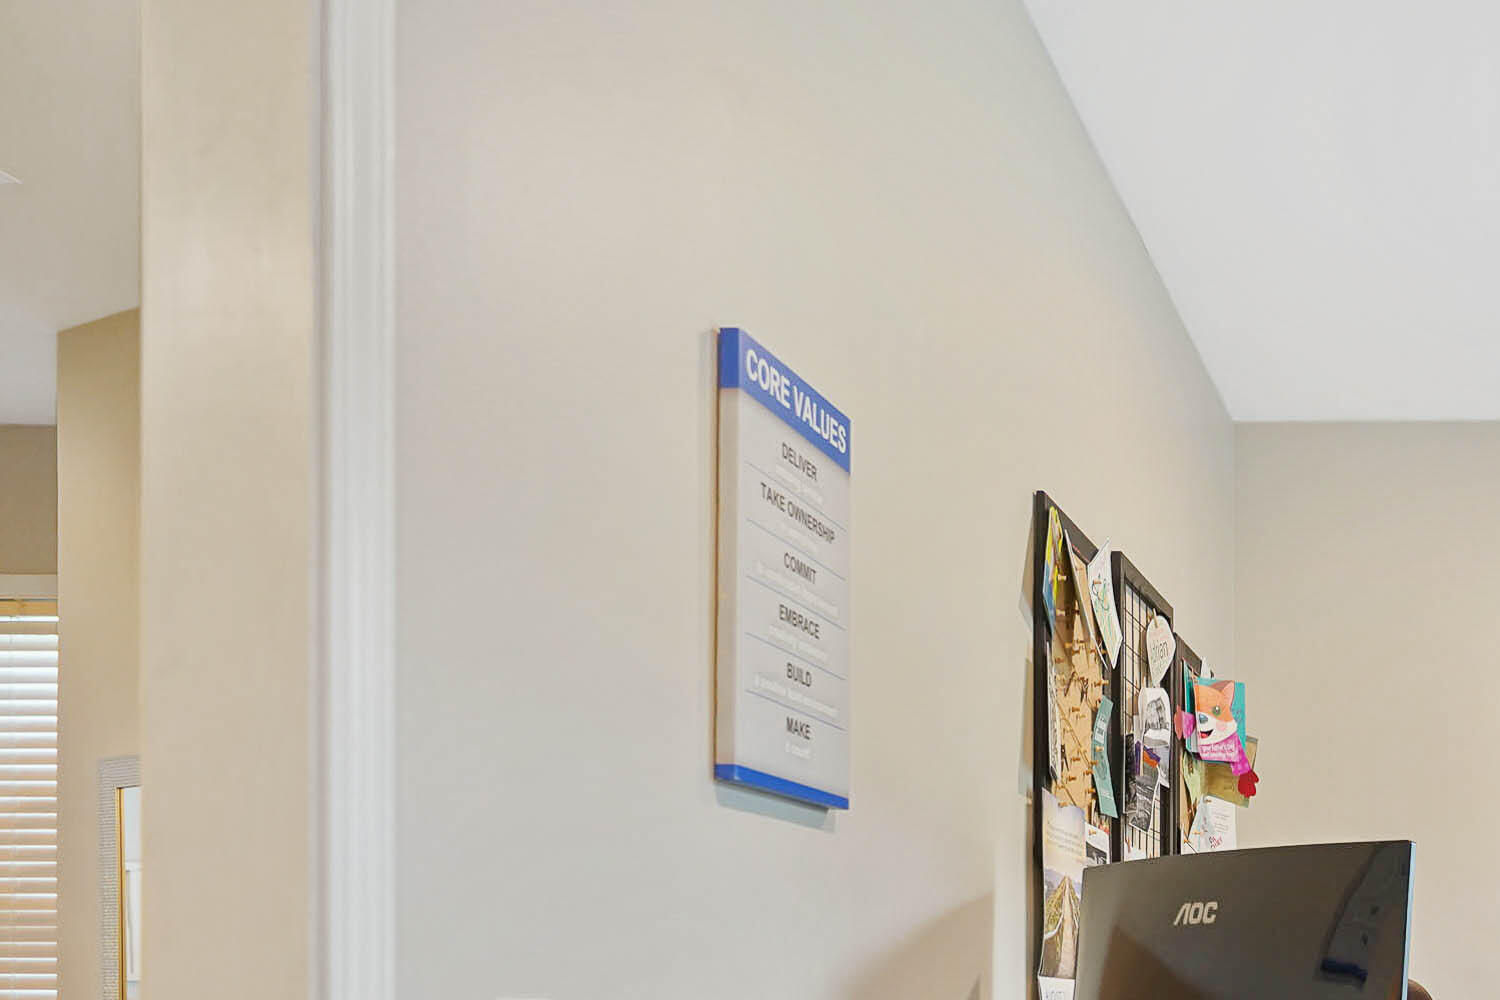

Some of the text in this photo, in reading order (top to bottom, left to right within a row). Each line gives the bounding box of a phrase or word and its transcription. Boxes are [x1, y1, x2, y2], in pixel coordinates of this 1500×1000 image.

[746, 349, 846, 454] CORE VALUES
[782, 441, 817, 481] DELIVER
[760, 481, 786, 512] TAKE
[787, 501, 836, 543] OWNERSHIP
[783, 552, 817, 584] COMMIT
[779, 604, 820, 639] EMBRACE
[786, 662, 812, 687] BUILD
[786, 716, 811, 740] MAKE
[1173, 901, 1218, 926] AOC
